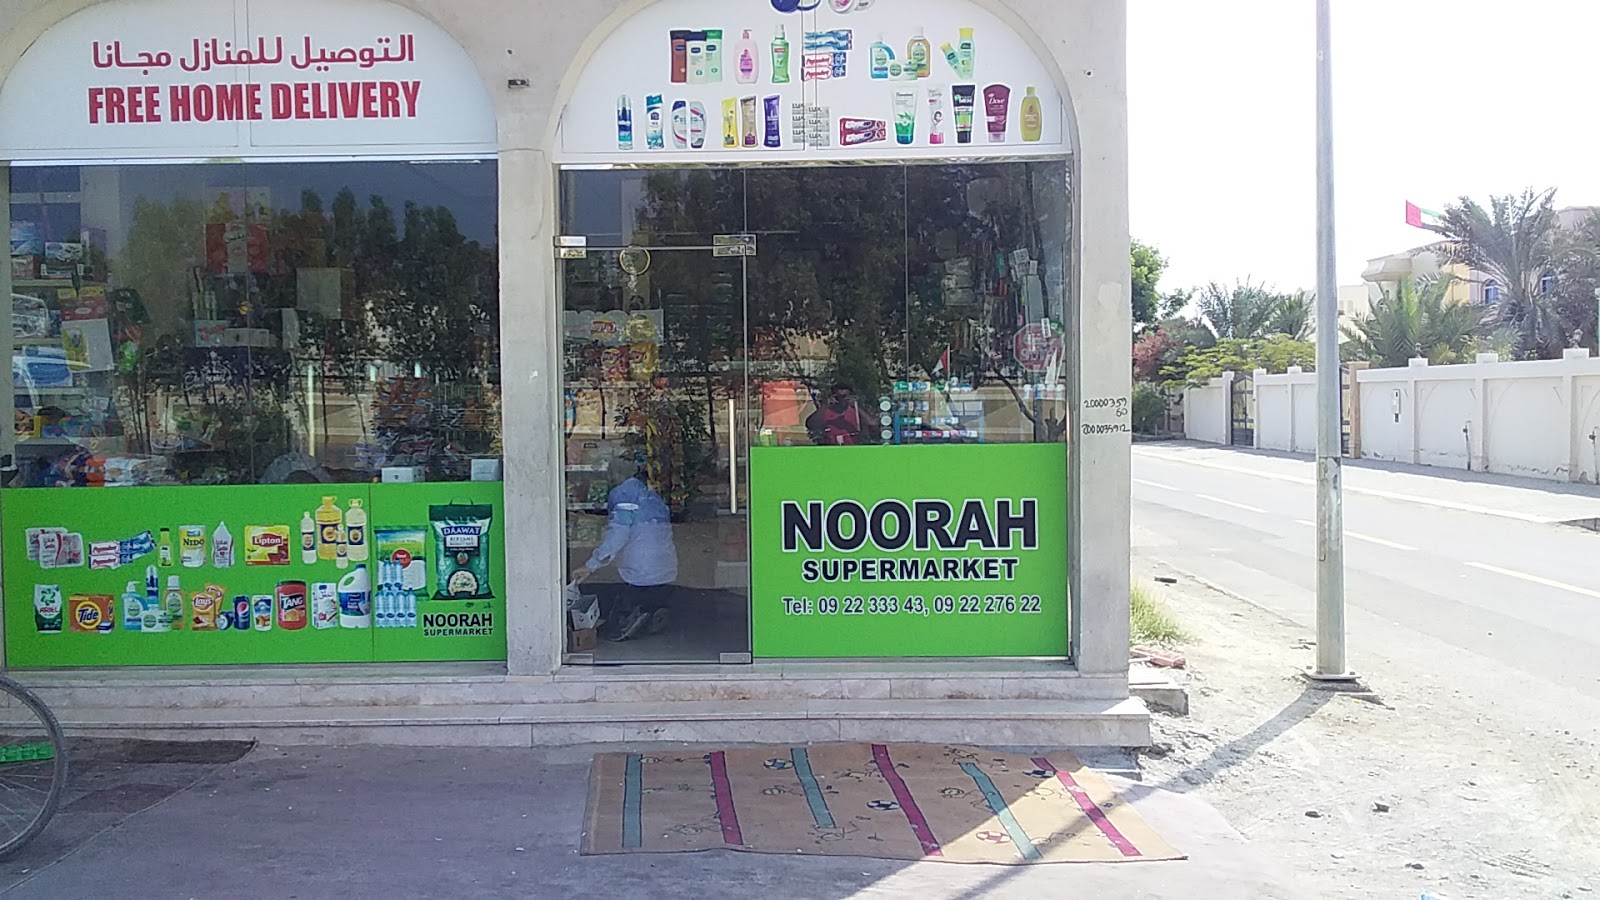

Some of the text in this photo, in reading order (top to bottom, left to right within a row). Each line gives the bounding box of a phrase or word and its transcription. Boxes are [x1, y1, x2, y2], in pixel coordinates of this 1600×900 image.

[92, 34, 415, 76] التوصيل للمنازل مجانا
[88, 81, 421, 124] FREE HOME DELIVERY
[443, 527, 480, 535] DAAWAT
[782, 499, 1037, 551] NOORAH
[183, 538, 205, 546] NIDO
[254, 537, 281, 545] Lipton
[802, 558, 1018, 581] SUPERMARKET
[281, 596, 303, 608] TANG
[782, 595, 1041, 617] Tel: 09 22 333 43, 09 22 276 22
[78, 607, 98, 623] Tide
[423, 613, 493, 628] NOORAH
[424, 628, 493, 636] SUPERMARKET
